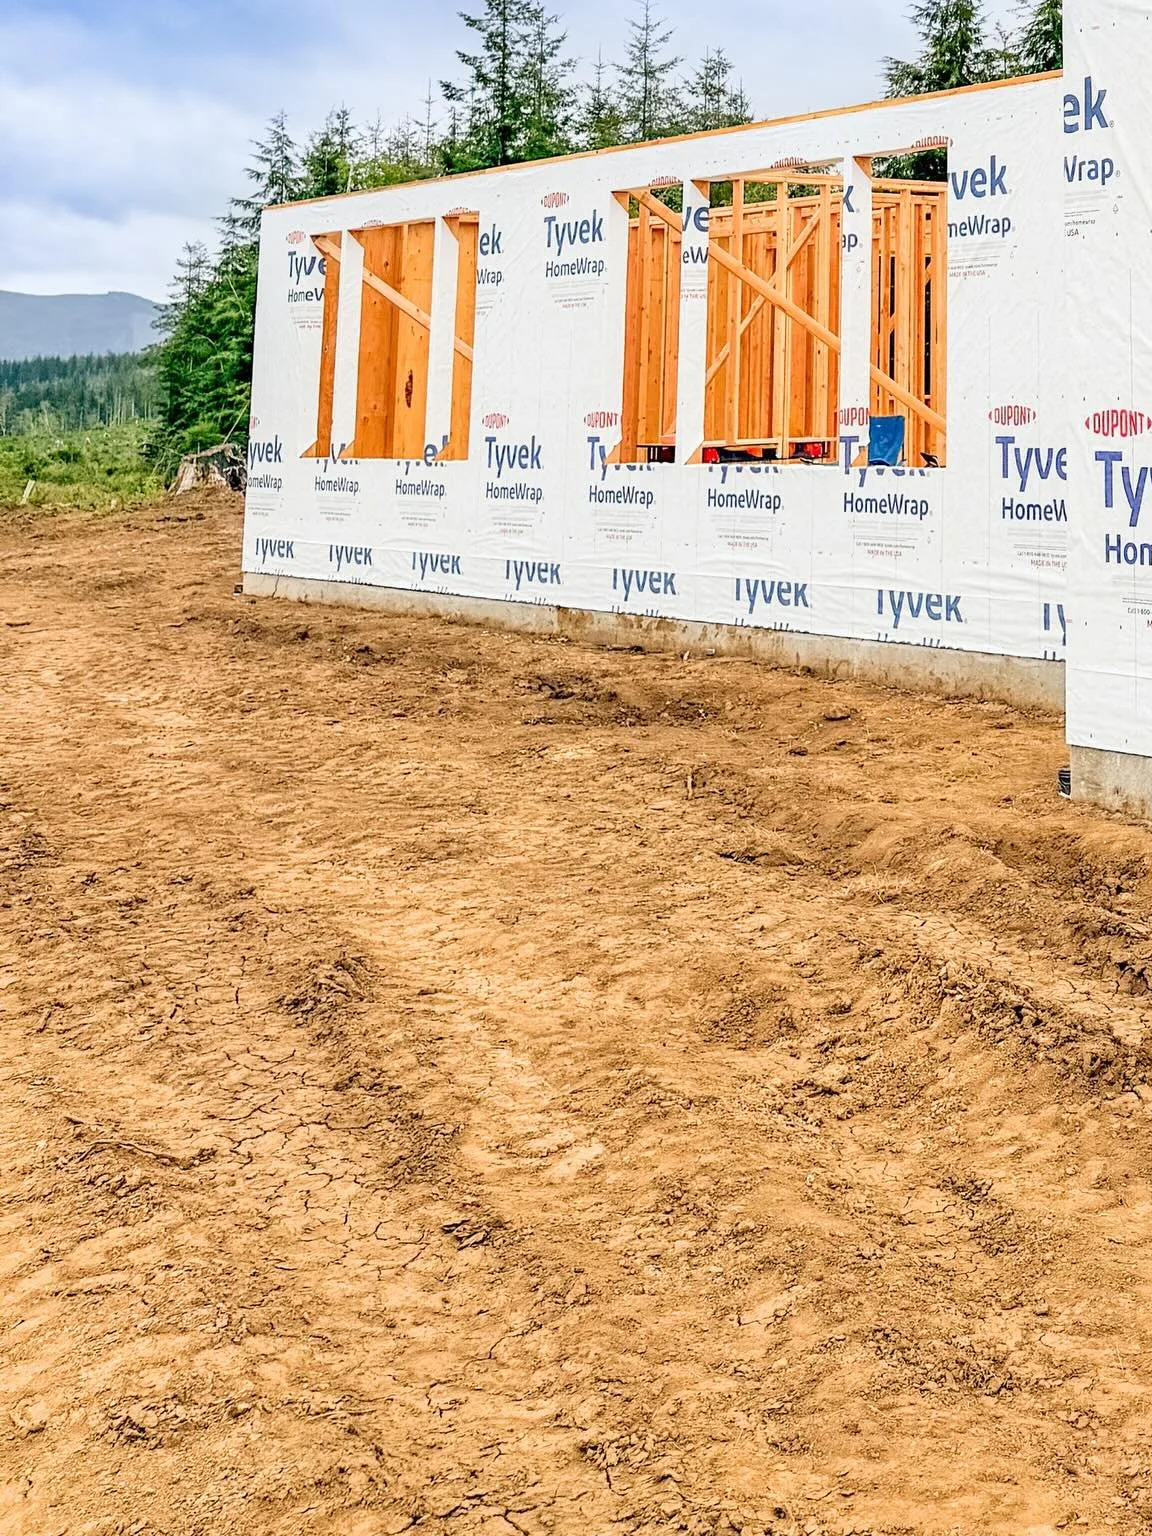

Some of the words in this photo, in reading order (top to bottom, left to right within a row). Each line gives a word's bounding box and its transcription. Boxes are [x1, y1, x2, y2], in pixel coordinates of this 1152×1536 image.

[544, 209, 604, 256] Tyvek
[546, 258, 604, 278] HomeWrap
[587, 411, 618, 428] DUPONT
[994, 405, 1031, 426] DUPONT
[1093, 409, 1144, 437] DUPONT
[485, 435, 541, 478] Tyvek
[314, 476, 359, 493] HomeWrap
[395, 480, 445, 497] HomeWrap
[486, 482, 542, 504] HomeWrap
[589, 485, 654, 509] HomeWrap
[708, 488, 781, 513] HomeWrap
[843, 493, 928, 520] HomeWrap
